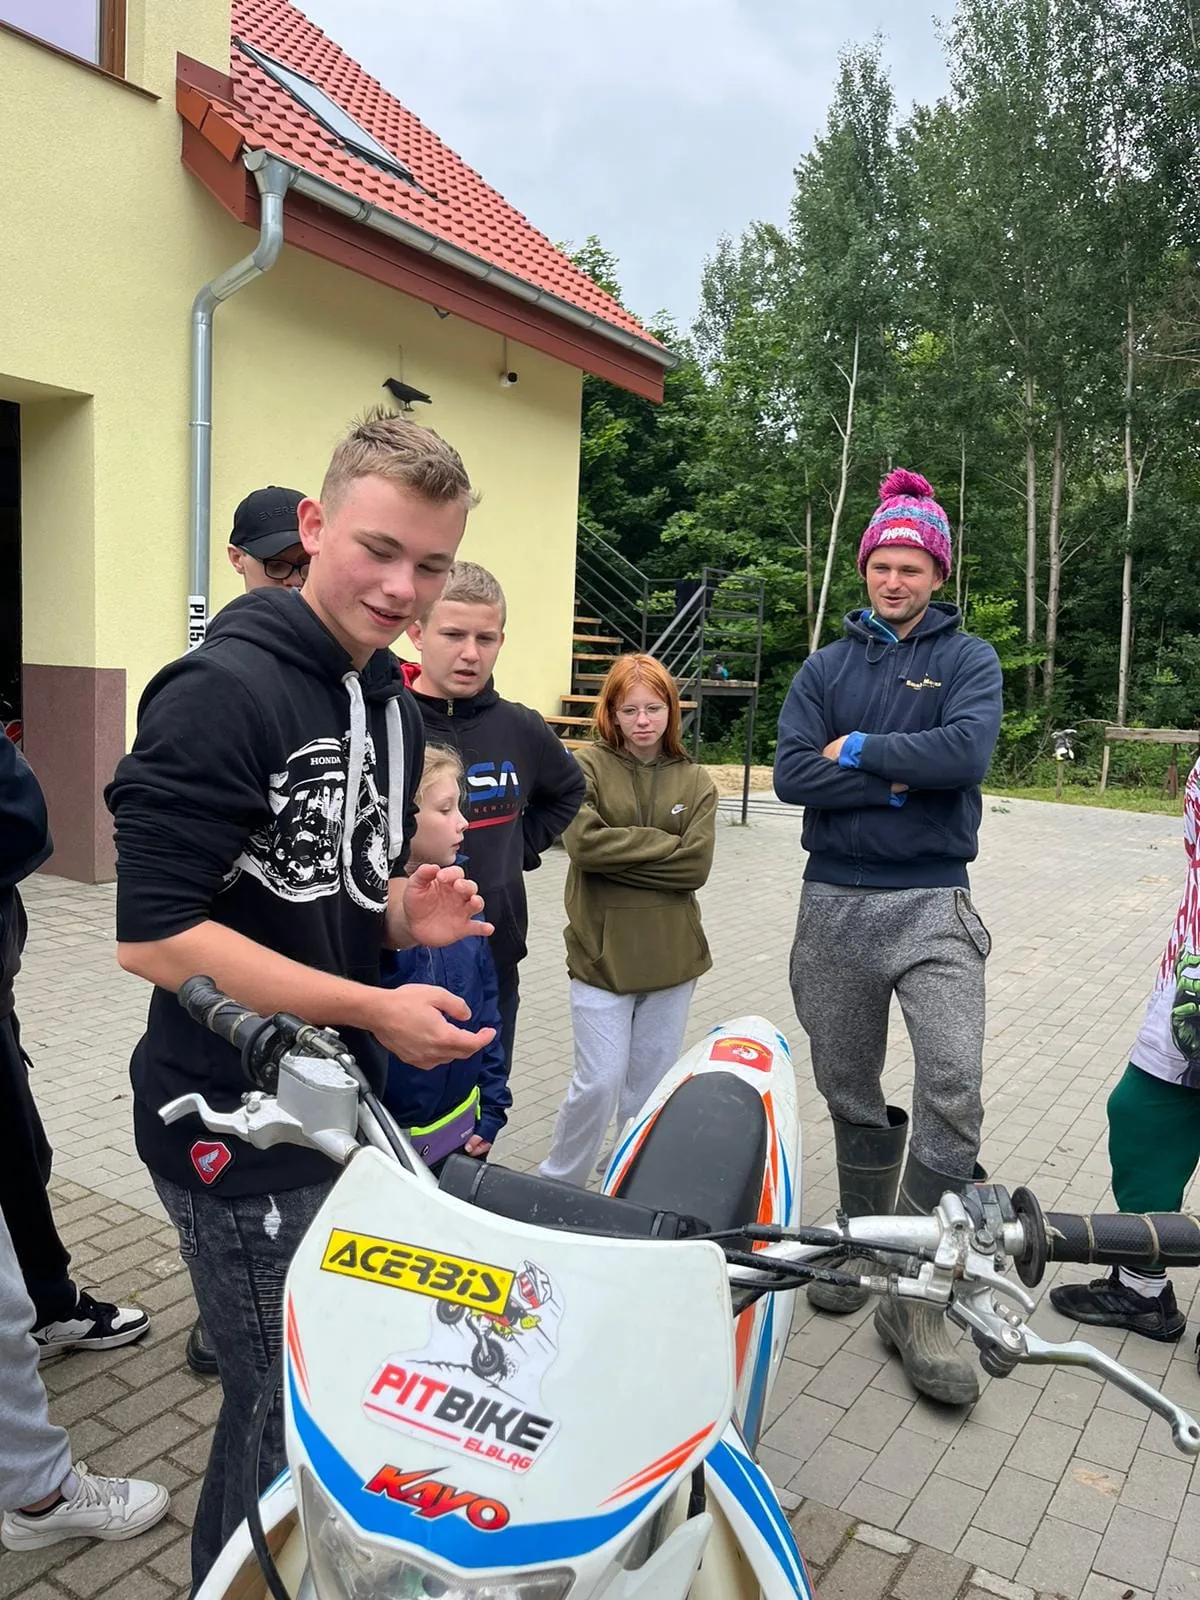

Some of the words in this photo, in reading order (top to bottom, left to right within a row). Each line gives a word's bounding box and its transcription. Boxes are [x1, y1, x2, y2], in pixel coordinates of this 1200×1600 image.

[189, 604, 205, 648] PL15
[310, 756, 341, 766] HONDA
[467, 761, 519, 802] SA
[370, 1363, 555, 1452] PITBIKE
[363, 1463, 512, 1532] KAYO
